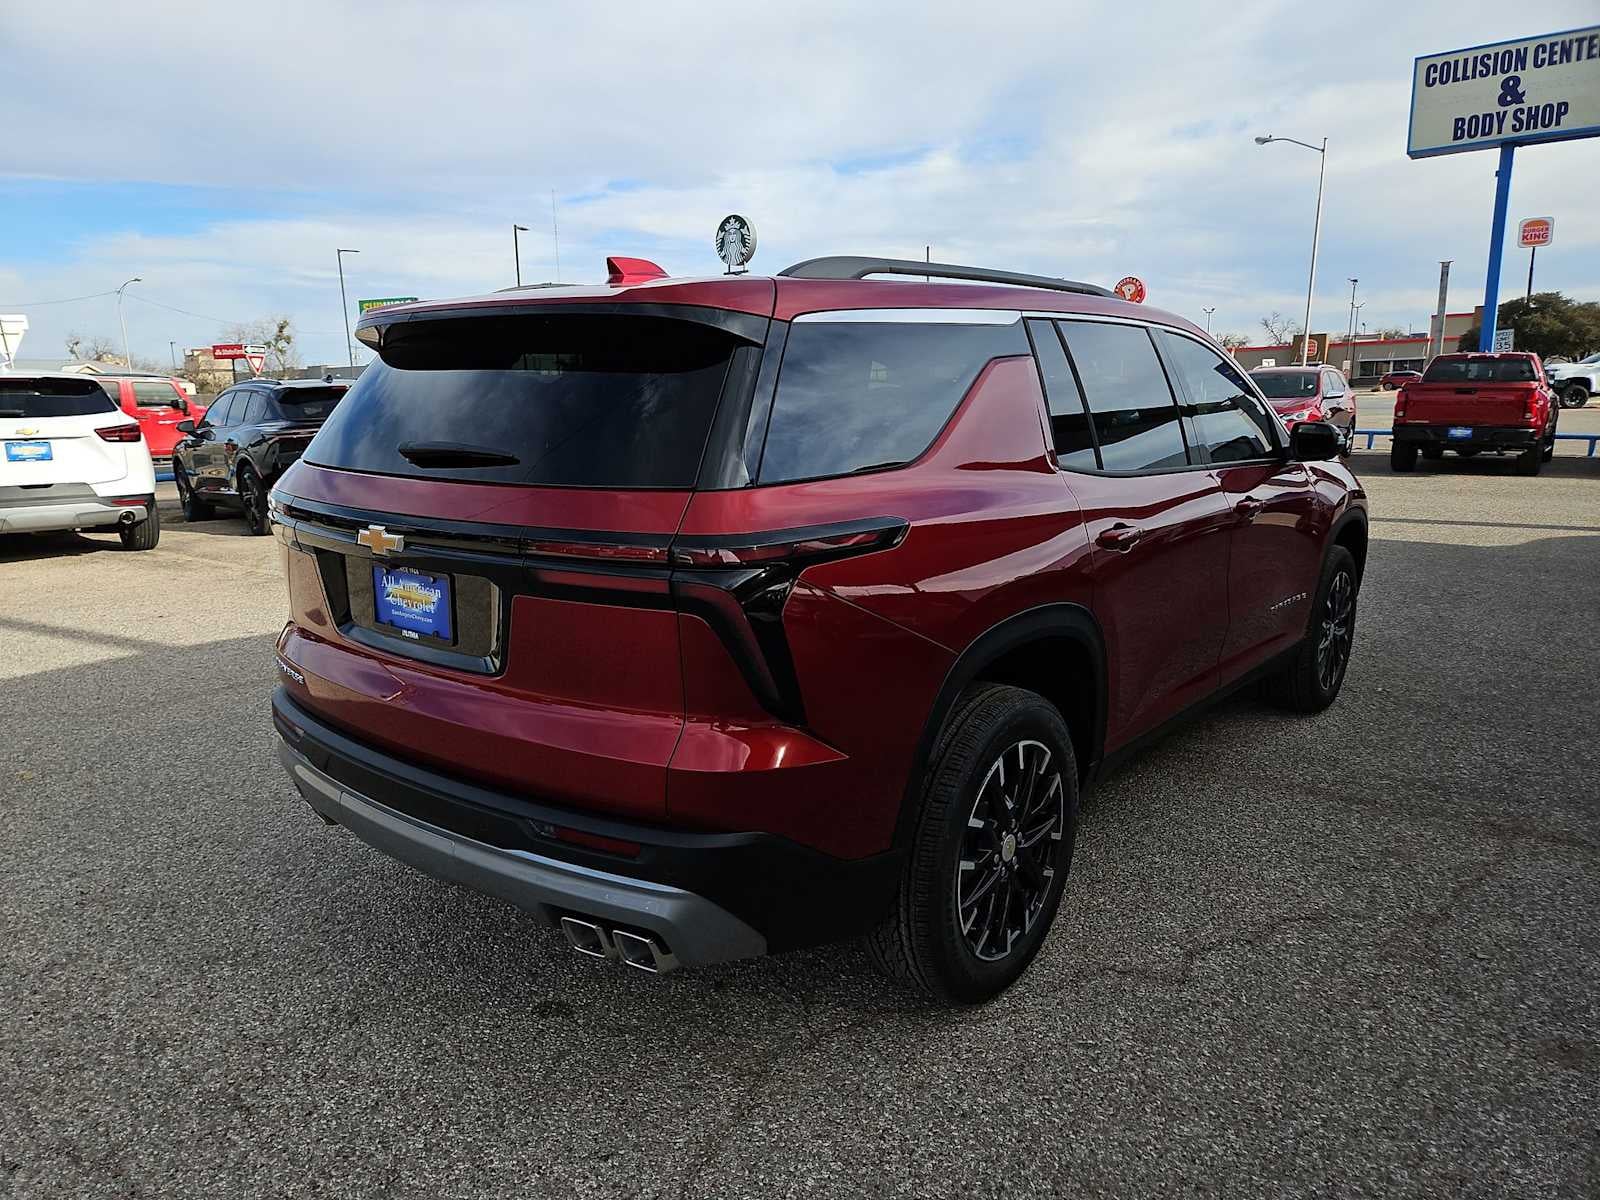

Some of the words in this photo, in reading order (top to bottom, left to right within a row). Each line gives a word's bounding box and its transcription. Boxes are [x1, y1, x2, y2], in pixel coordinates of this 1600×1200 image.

[1425, 46, 1529, 88] COLLISION
[1532, 34, 1600, 69] CENTE
[1497, 75, 1526, 108] &
[1452, 109, 1509, 142] BODY
[1511, 101, 1569, 133] SHOP
[1522, 226, 1549, 234] BURGER
[1522, 232, 1549, 241] KING
[381, 575, 395, 587] All
[399, 578, 442, 599] American
[389, 592, 436, 614] Chevrolet
